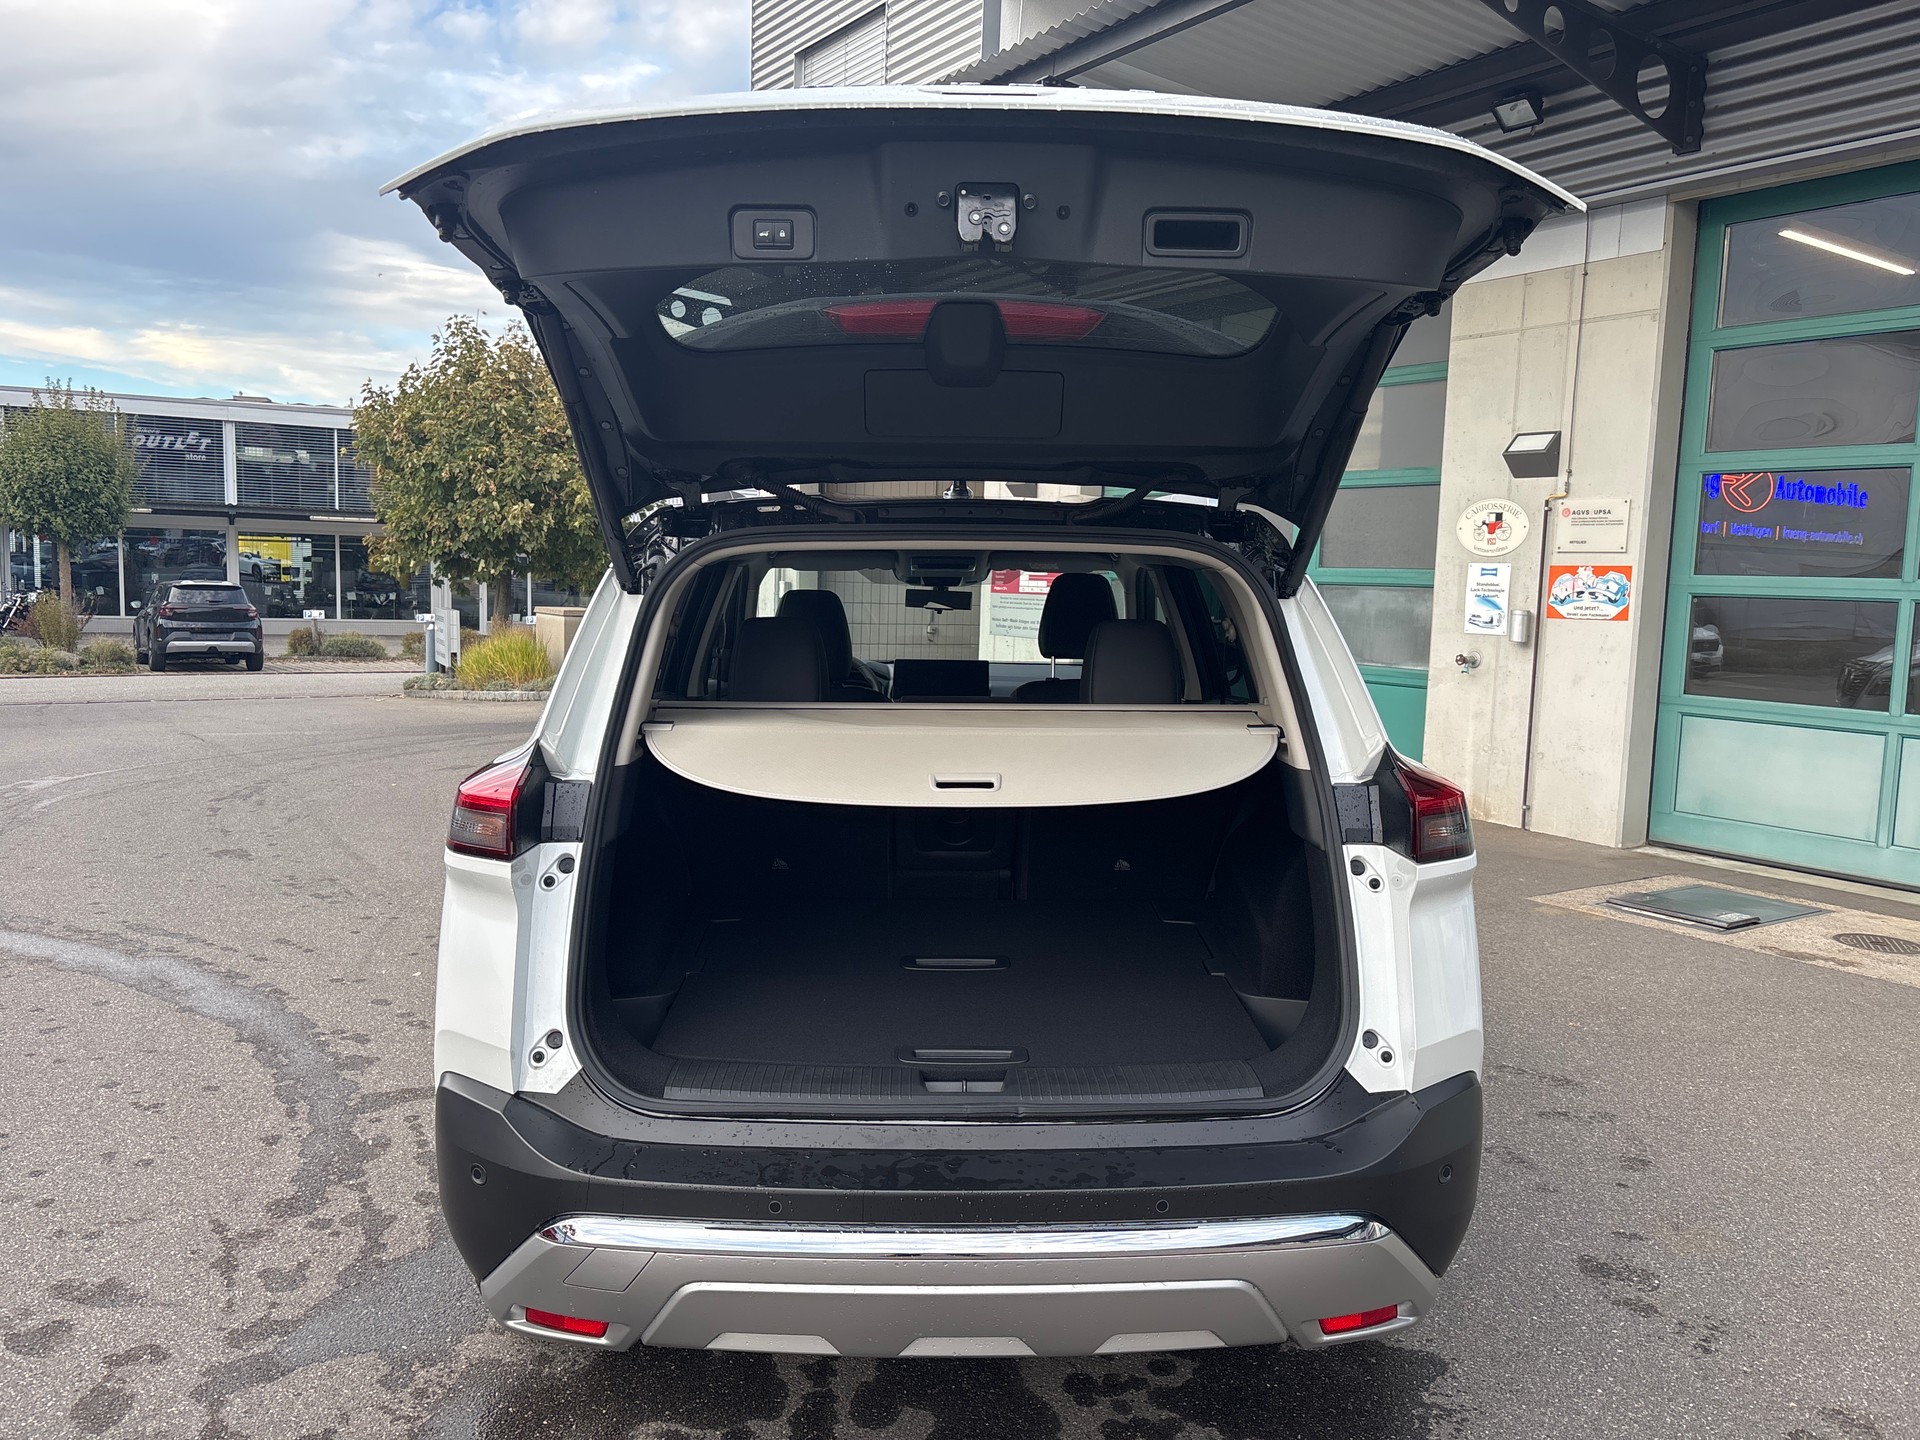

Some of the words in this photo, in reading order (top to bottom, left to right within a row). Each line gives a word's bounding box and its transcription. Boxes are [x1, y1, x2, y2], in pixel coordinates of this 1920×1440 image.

[185, 453, 207, 461] store
[1774, 475, 1869, 510] Automobile
[1465, 502, 1522, 520] CARROSSERIE
[1730, 522, 1772, 540] Wettingen
